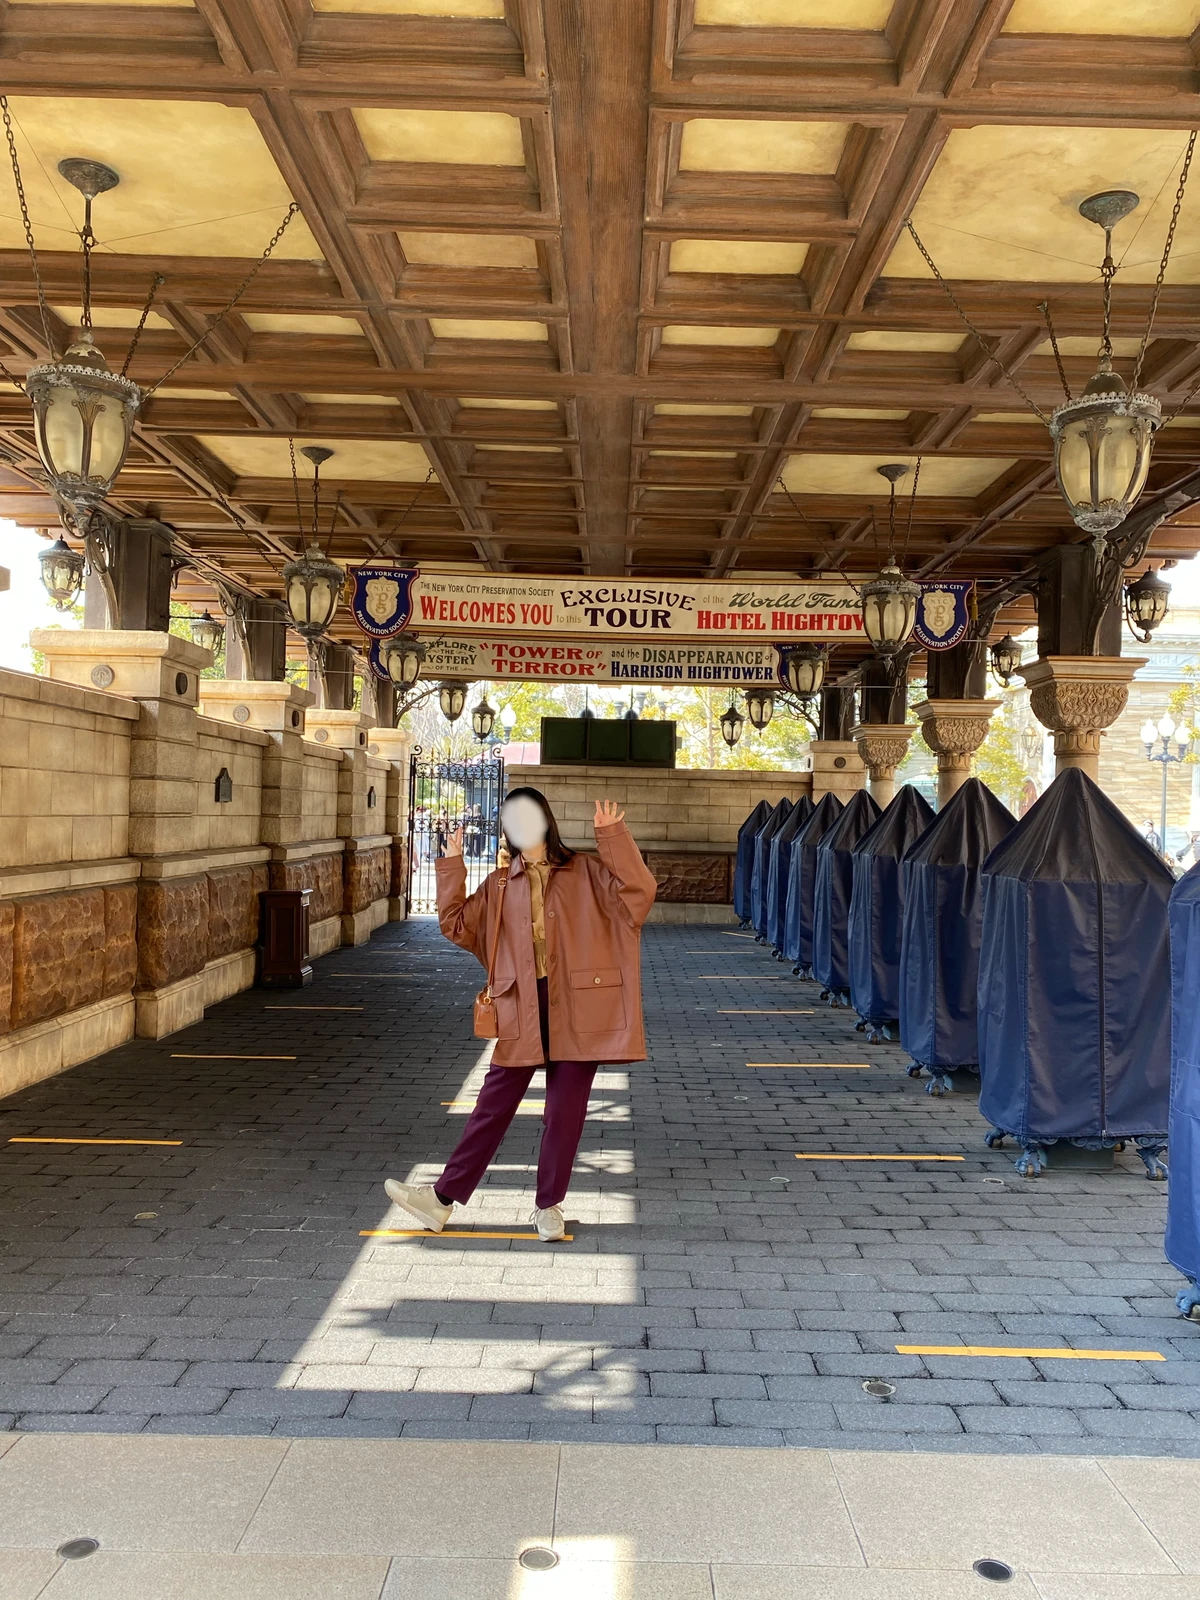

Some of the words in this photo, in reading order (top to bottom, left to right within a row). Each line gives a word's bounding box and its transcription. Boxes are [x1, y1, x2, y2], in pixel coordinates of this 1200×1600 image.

[420, 581, 430, 589] THE
[432, 583, 446, 592] NEW
[448, 584, 464, 593] YORK
[466, 584, 480, 594] CITY
[482, 585, 526, 596] PRESERVATION
[528, 586, 555, 597] SOCIETY
[560, 588, 696, 611] EXCLUSIVE
[703, 594, 712, 604] of
[712, 595, 725, 604] the
[728, 591, 804, 608] World
[420, 595, 516, 624] WELCOMES
[519, 603, 554, 626] YOU
[566, 615, 582, 624] this
[584, 607, 672, 629] TOUR
[697, 610, 766, 630] HOTEL
[356, 610, 389, 635] PRESERVATION
[389, 612, 407, 633] SOCIETY
[915, 624, 948, 648] PRESERVATION
[948, 624, 965, 645] SOCIETY
[586, 650, 602, 659] OF
[611, 648, 625, 659] and
[627, 648, 640, 660] the
[643, 648, 763, 665] DISAPPEARANCE
[765, 652, 774, 663] of
[611, 661, 683, 679] HARRISON
[687, 665, 774, 680] HIGHTOWER
